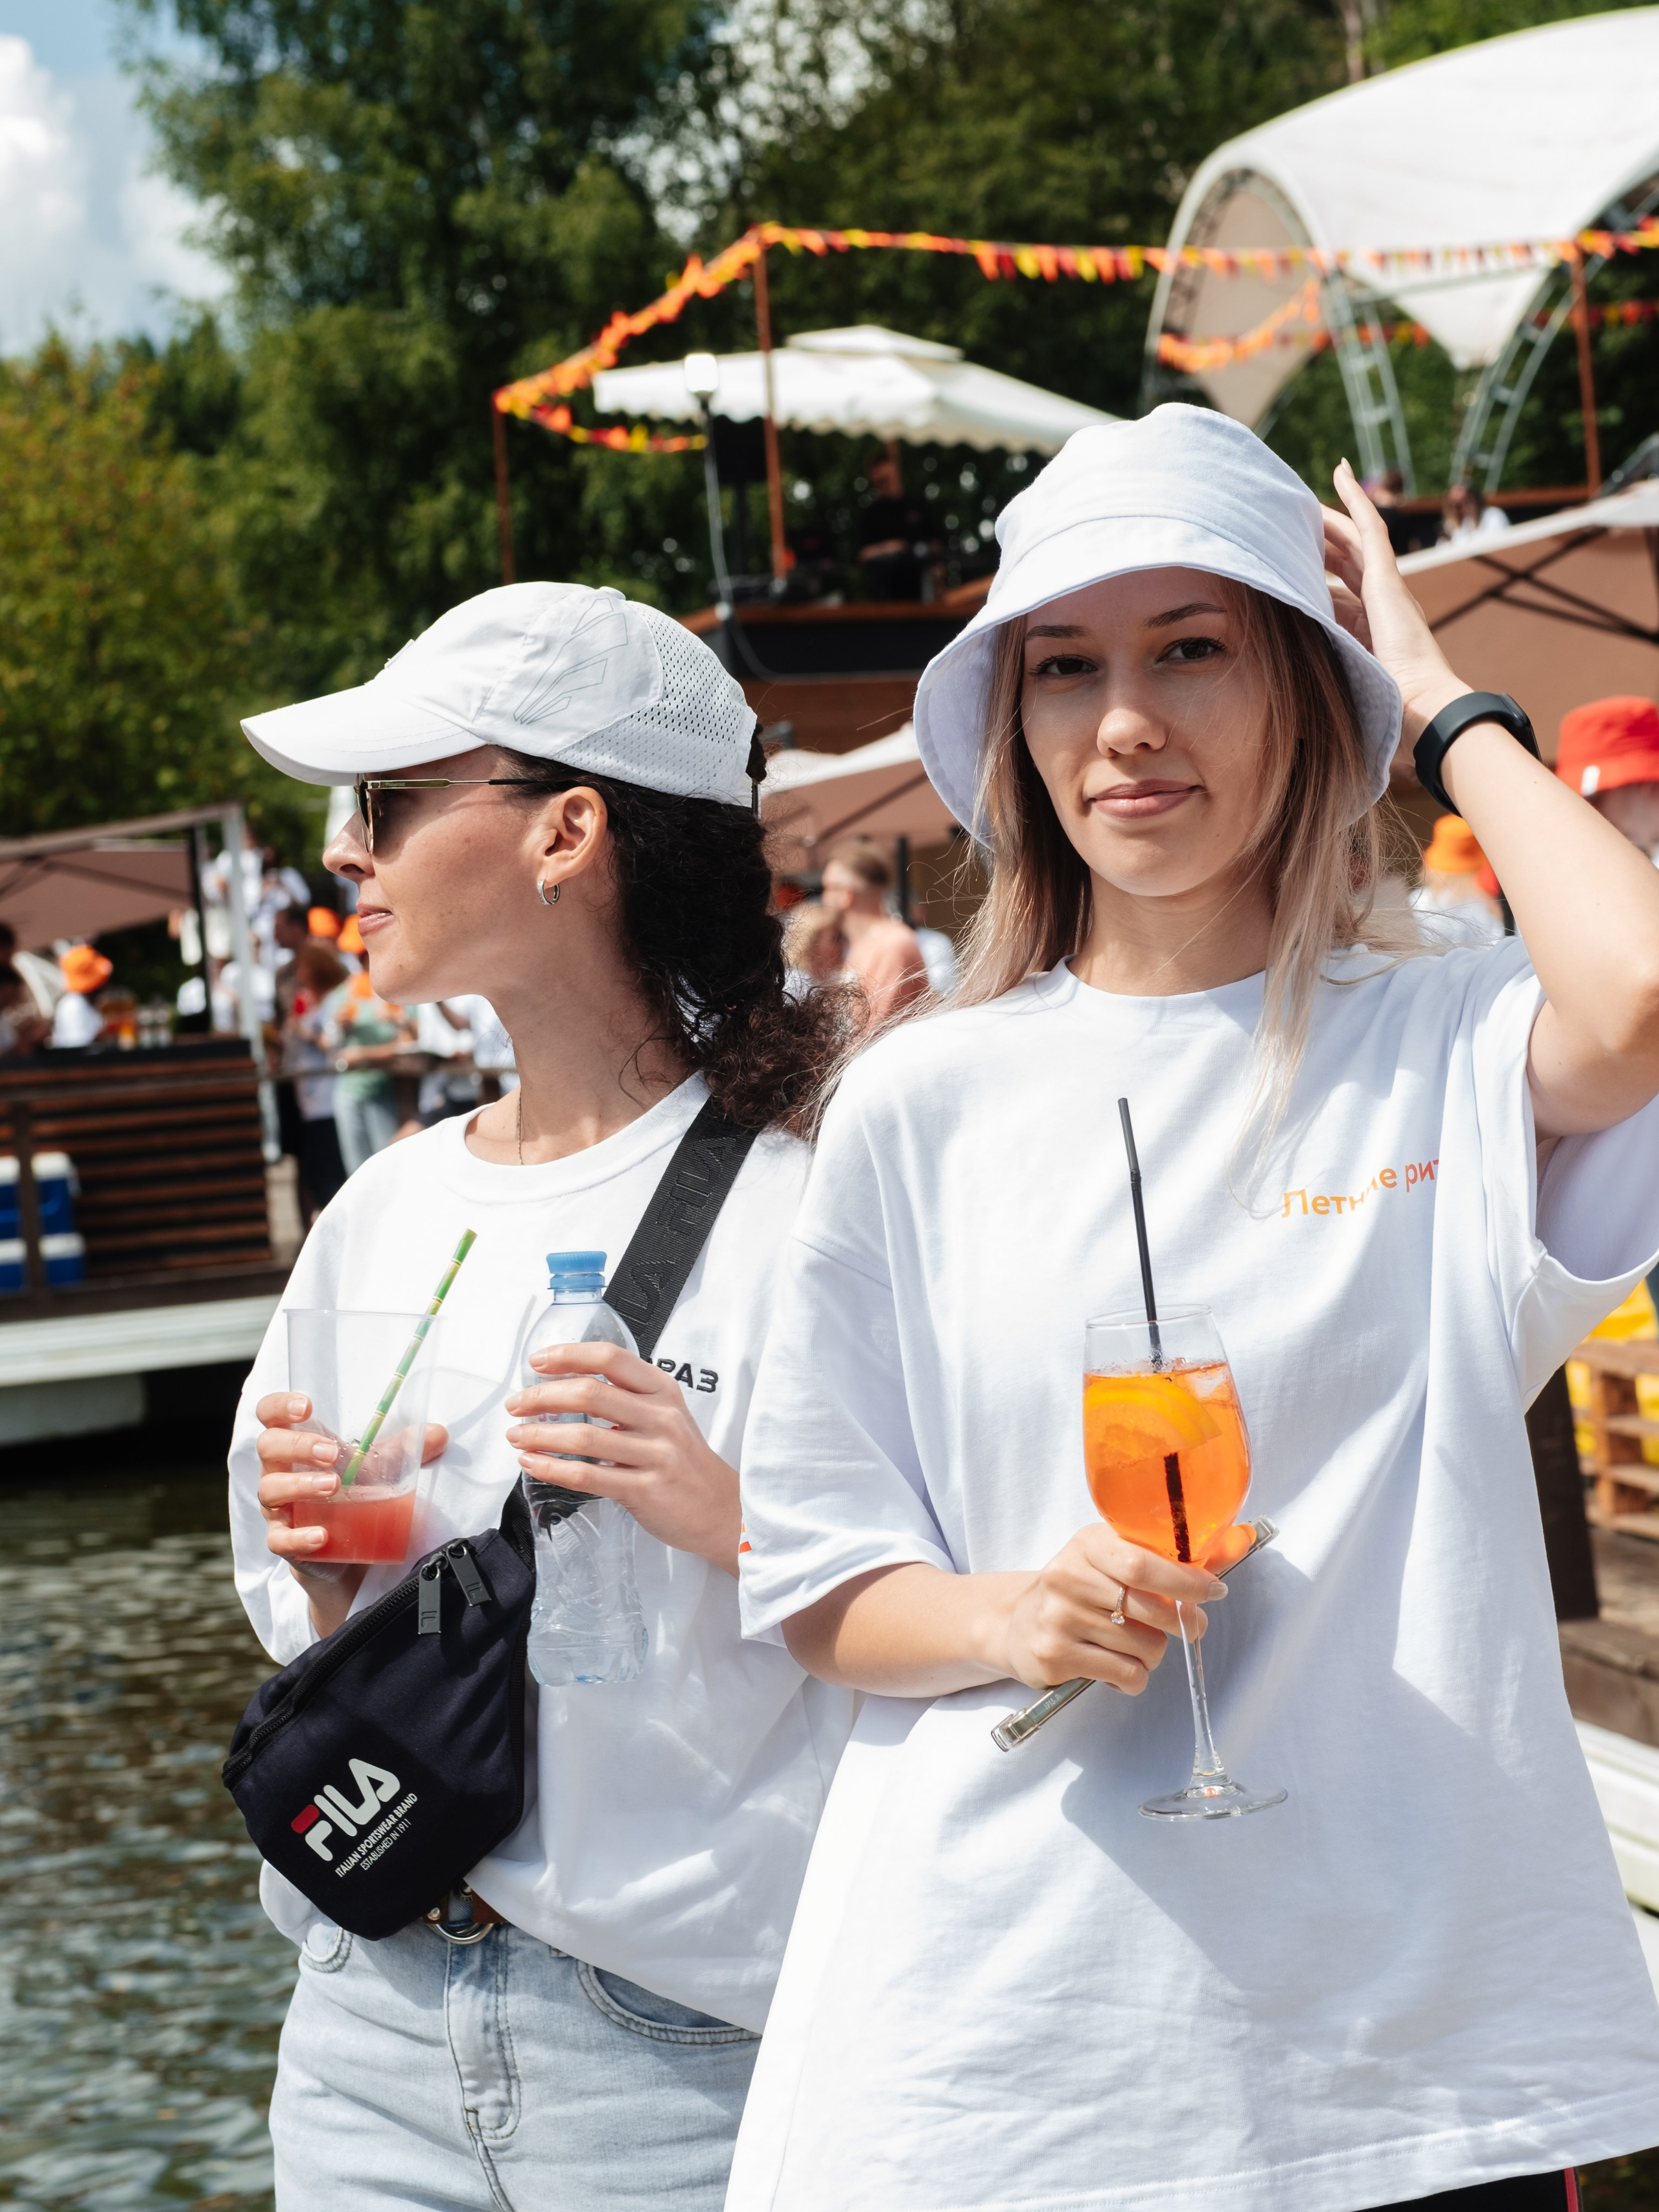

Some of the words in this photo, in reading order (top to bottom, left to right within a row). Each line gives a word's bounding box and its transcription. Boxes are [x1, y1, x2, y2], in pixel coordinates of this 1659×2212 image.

[647, 1357, 719, 1393] РАЗ
[291, 1758, 400, 1861] FILA
[334, 1851, 362, 1878] ITALIAN
[357, 1814, 399, 1856] SPORTSWEAR
[393, 1793, 418, 1818] BRAND
[360, 1837, 393, 1870] ESTABLISHED
[389, 1830, 400, 1841] IN
[395, 1818, 412, 1834] 1911
